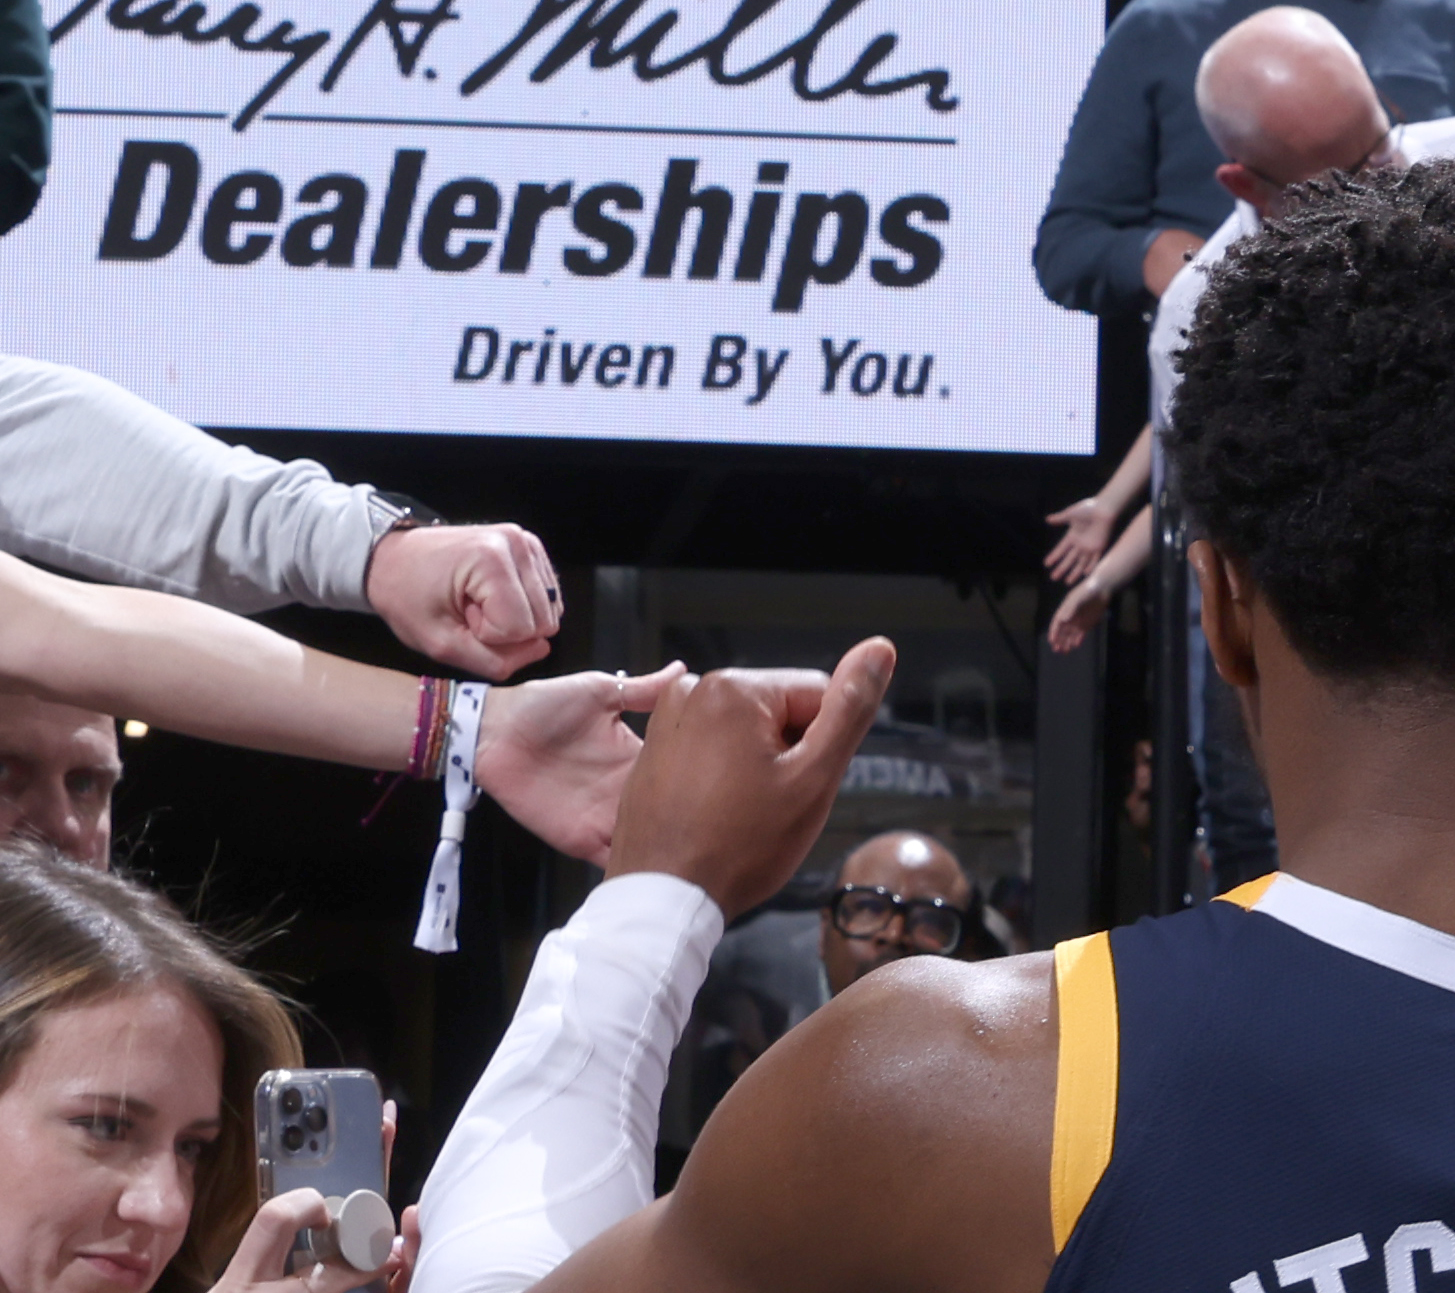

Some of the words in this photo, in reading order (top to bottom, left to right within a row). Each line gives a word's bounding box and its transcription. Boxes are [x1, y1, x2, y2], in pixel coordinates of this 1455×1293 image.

[96, 139, 952, 312] Dealerships
[452, 325, 675, 388] Driven
[701, 333, 790, 406] By
[820, 337, 949, 399] You.
